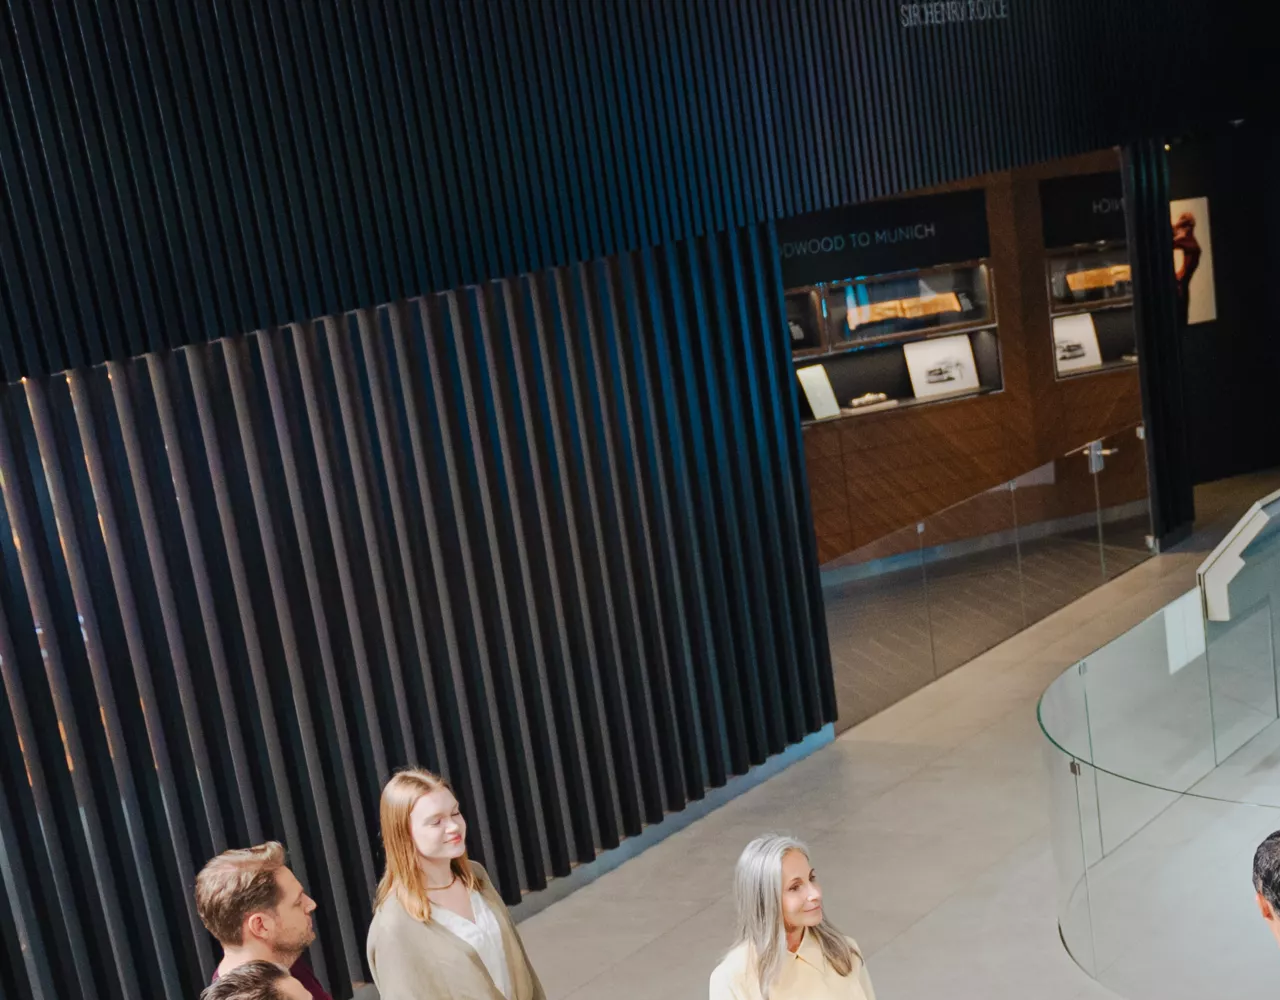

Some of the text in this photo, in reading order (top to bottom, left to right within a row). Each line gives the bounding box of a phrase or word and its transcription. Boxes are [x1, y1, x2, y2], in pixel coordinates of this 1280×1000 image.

[900, 3, 921, 27] SIR
[923, 1, 965, 25] HENRY
[780, 222, 936, 259] DWOOD TO MUNICH
